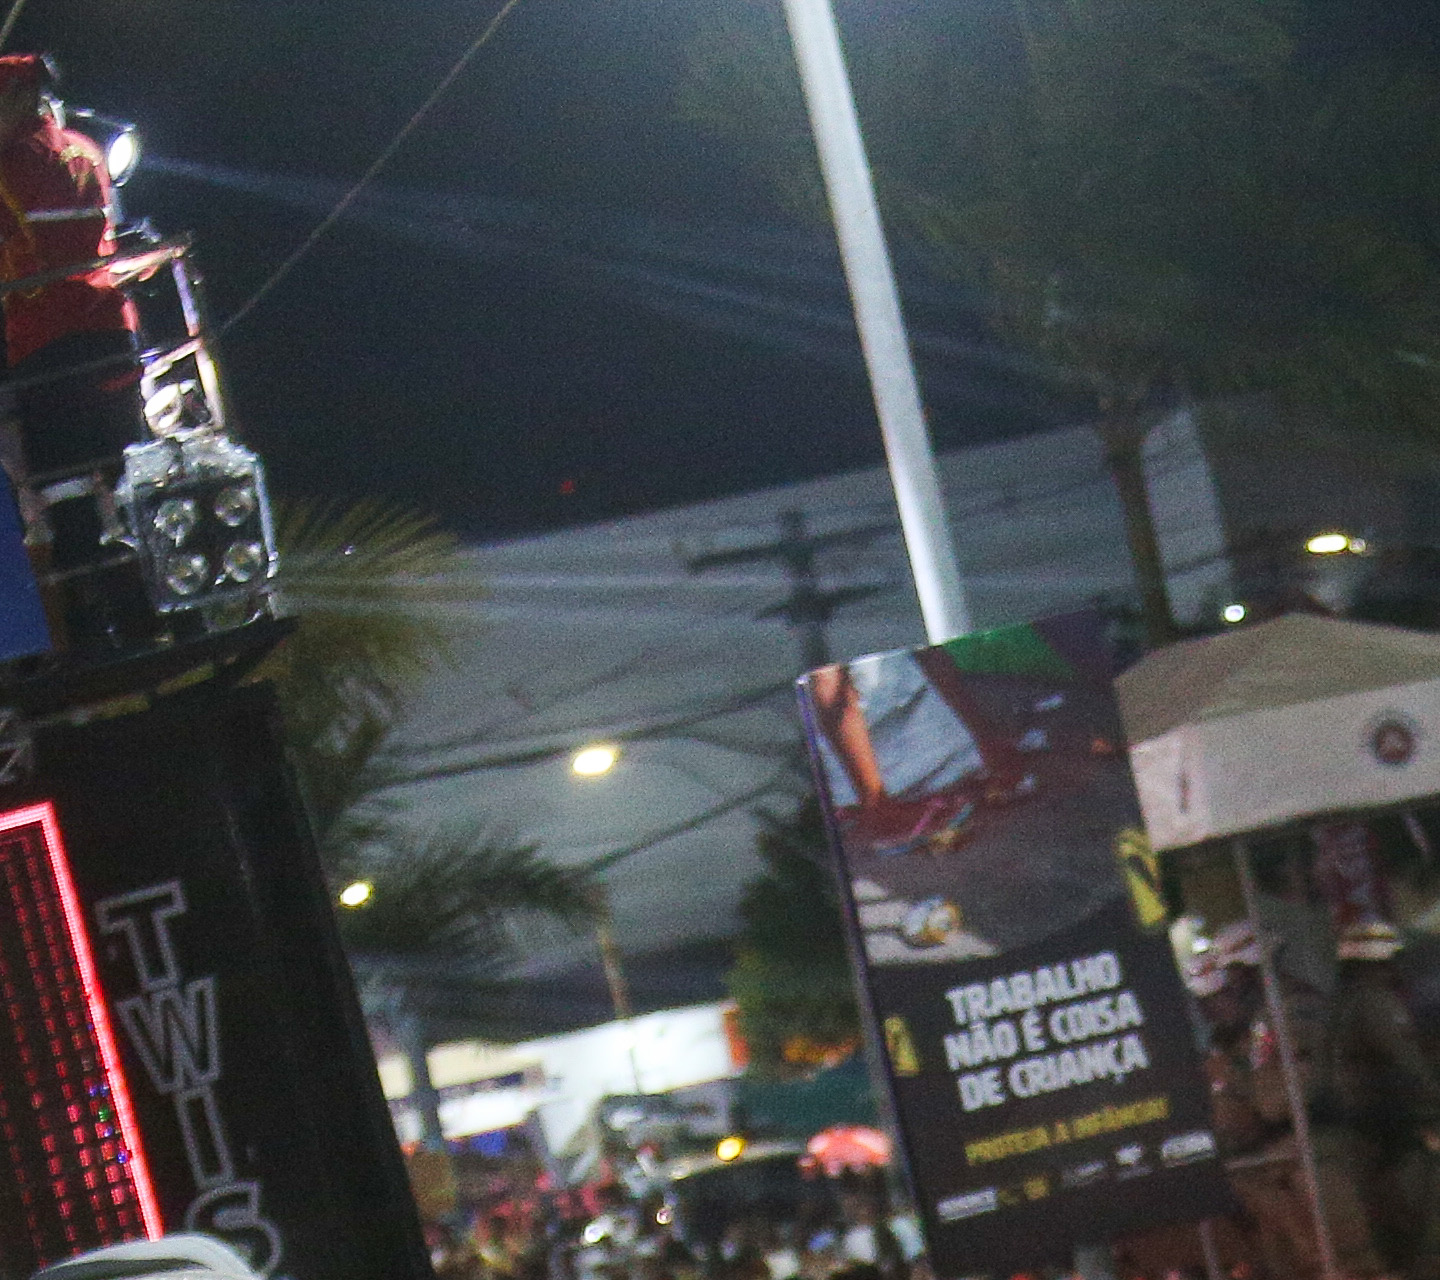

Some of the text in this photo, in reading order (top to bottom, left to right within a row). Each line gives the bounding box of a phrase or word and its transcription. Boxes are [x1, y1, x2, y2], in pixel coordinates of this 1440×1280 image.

[945, 951, 1122, 1025] TRABALHO
[944, 1020, 1019, 1072] NÃO
[1049, 990, 1144, 1044] COISA
[958, 1033, 1150, 1112] DE CRIANÇA
